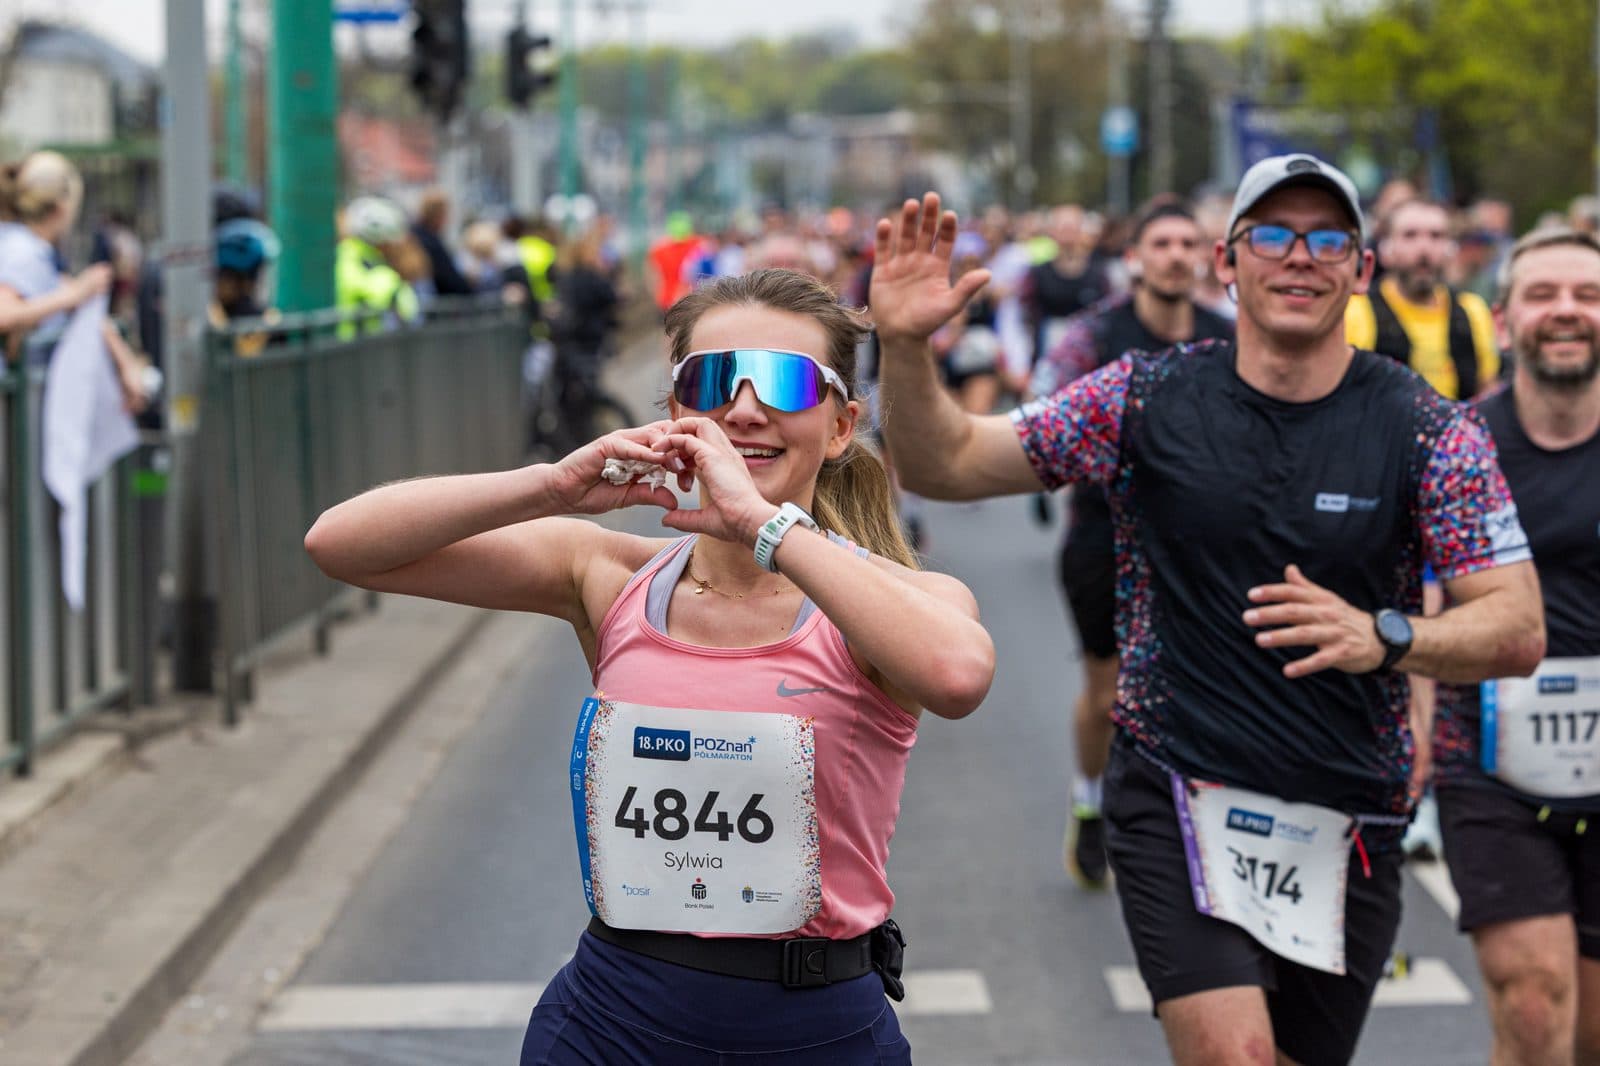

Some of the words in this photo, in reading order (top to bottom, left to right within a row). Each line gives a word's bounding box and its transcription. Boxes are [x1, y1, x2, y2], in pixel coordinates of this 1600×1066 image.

[637, 735, 686, 752] 18.PKO
[614, 785, 774, 844] 4846
[664, 851, 723, 872] Sylwia
